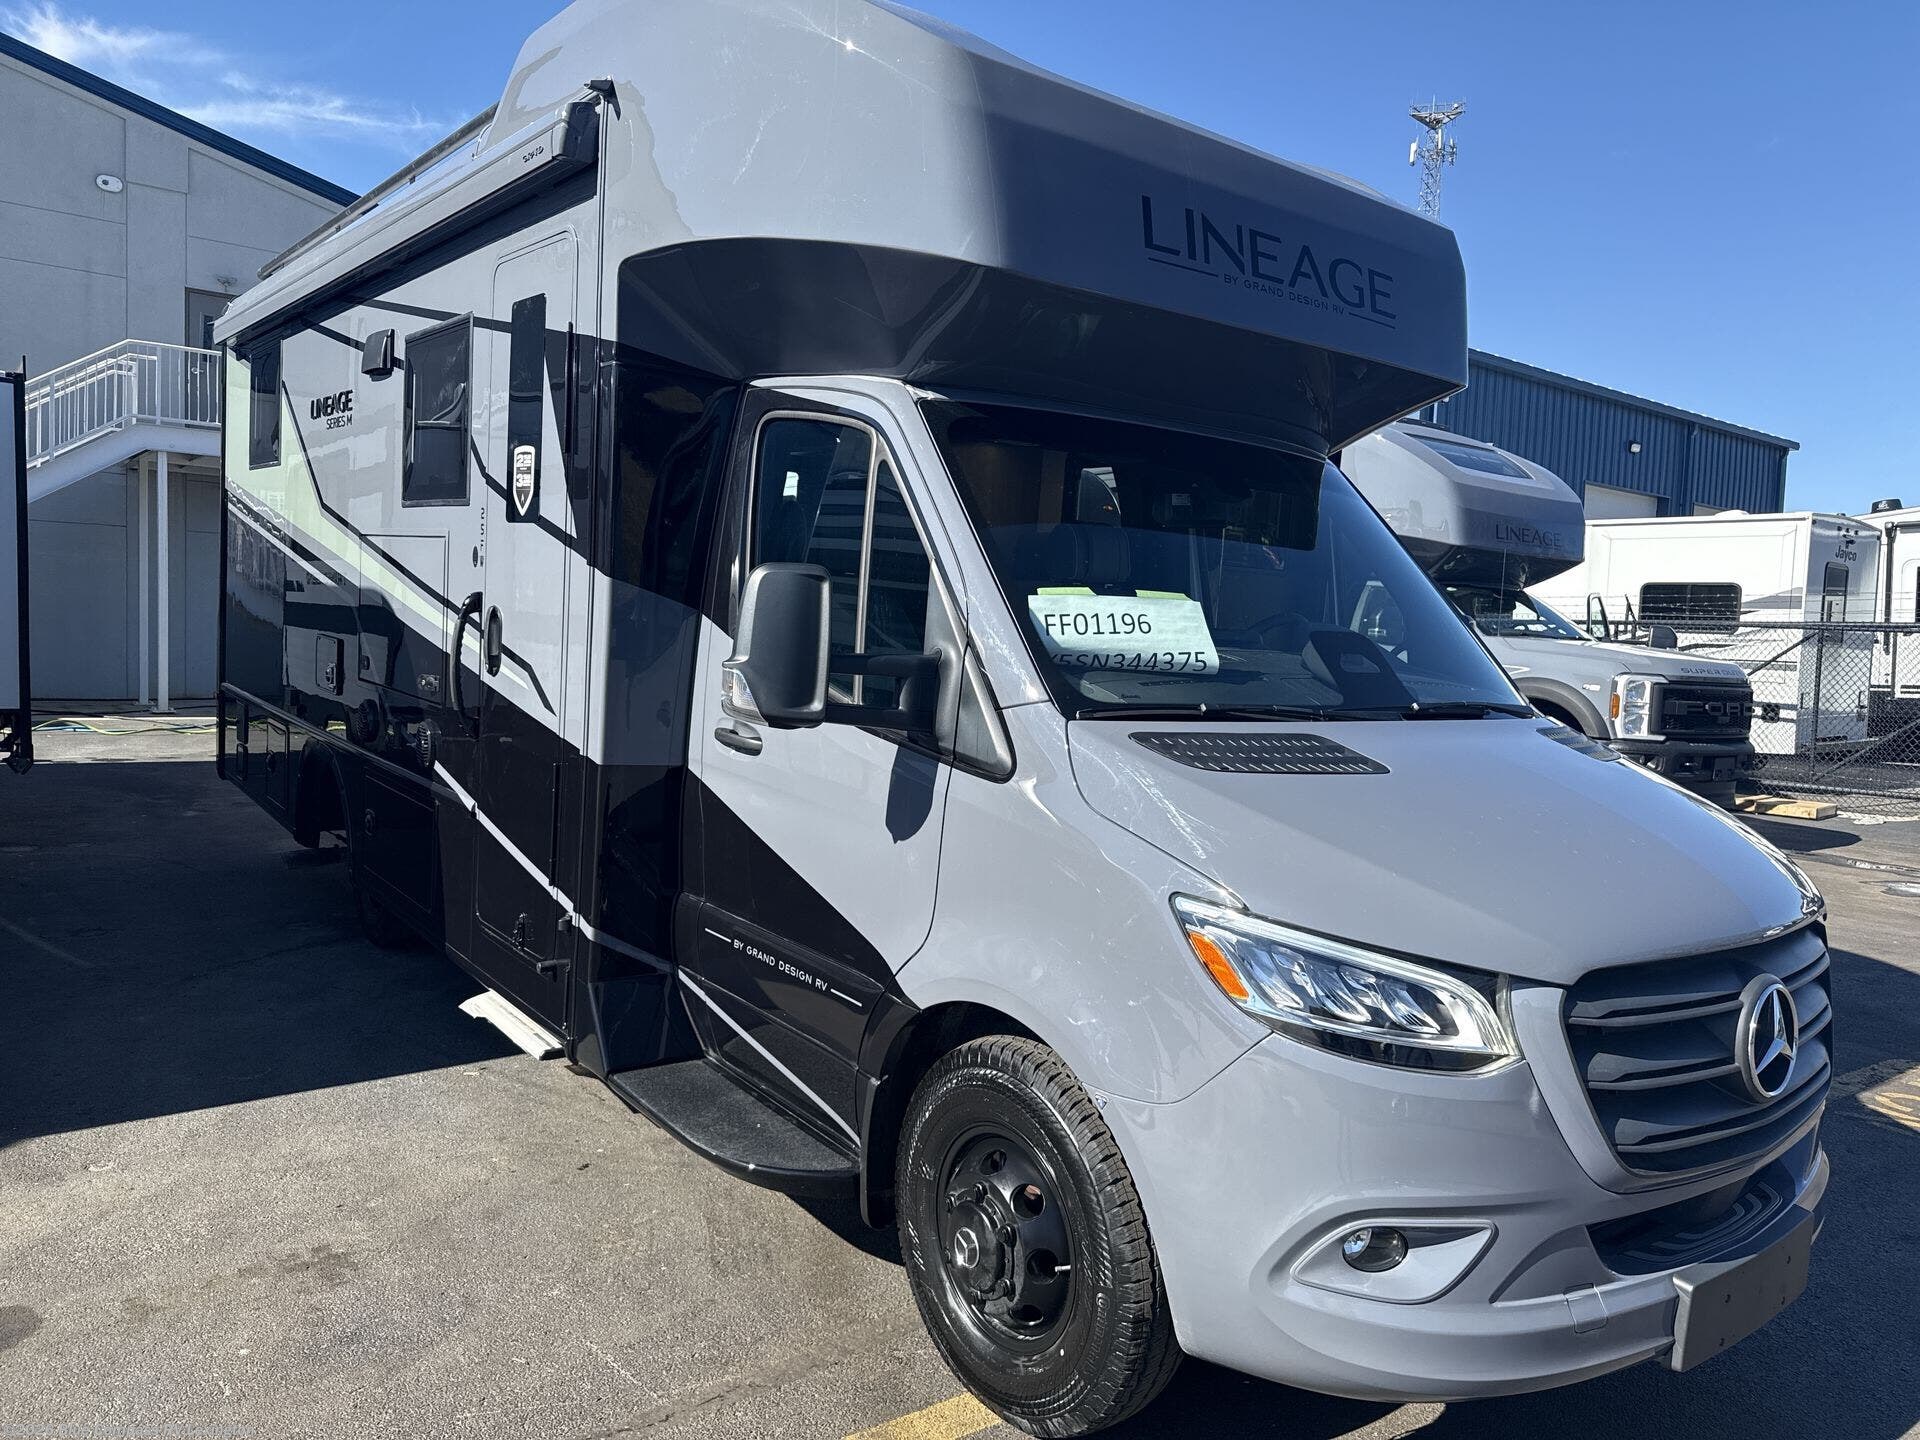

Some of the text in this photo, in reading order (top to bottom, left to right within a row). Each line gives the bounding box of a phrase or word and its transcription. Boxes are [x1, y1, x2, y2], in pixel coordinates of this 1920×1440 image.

[1141, 194, 1396, 320] LINEAGE
[1223, 273, 1345, 315] BY GRAND DESIGN RV
[310, 389, 353, 420] LINEAGE
[326, 413, 353, 430] SERIES M
[1495, 523, 1562, 547] LINEAGE
[1835, 545, 1857, 562] Jayco
[1044, 613, 1151, 636] FF01196
[1680, 667, 1721, 676] SUPER
[733, 939, 828, 991] BY GRAND DESIGN RV
